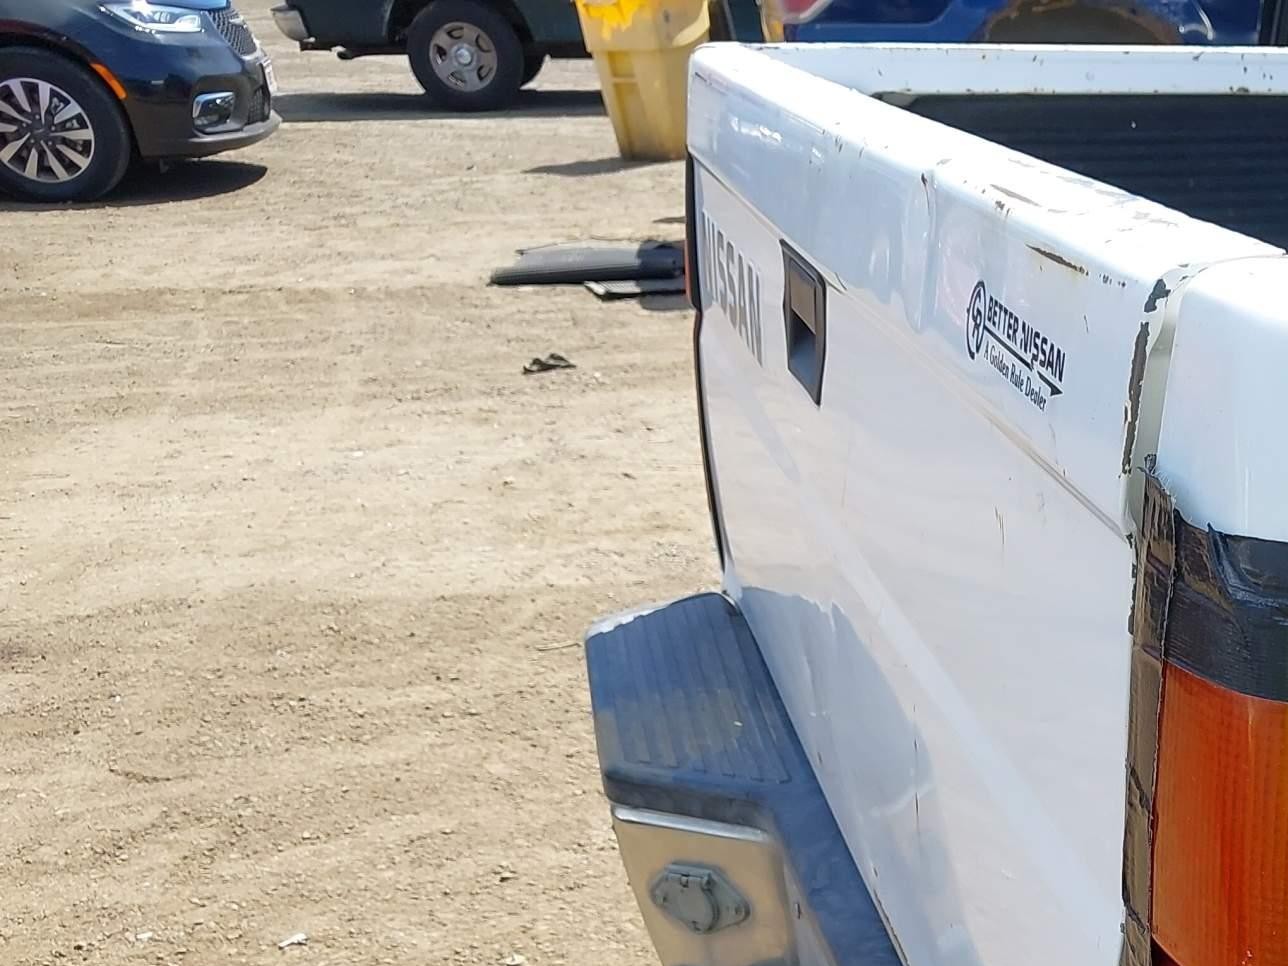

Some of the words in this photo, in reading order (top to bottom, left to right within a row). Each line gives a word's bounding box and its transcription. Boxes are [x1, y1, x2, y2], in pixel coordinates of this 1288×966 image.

[702, 210, 762, 367] NISSAN
[987, 295, 1019, 346] BETTER
[1020, 321, 1065, 382] NISSAN
[990, 345, 1010, 379] Golden
[1010, 364, 1024, 392] Rule
[1025, 376, 1046, 410] Dealer
